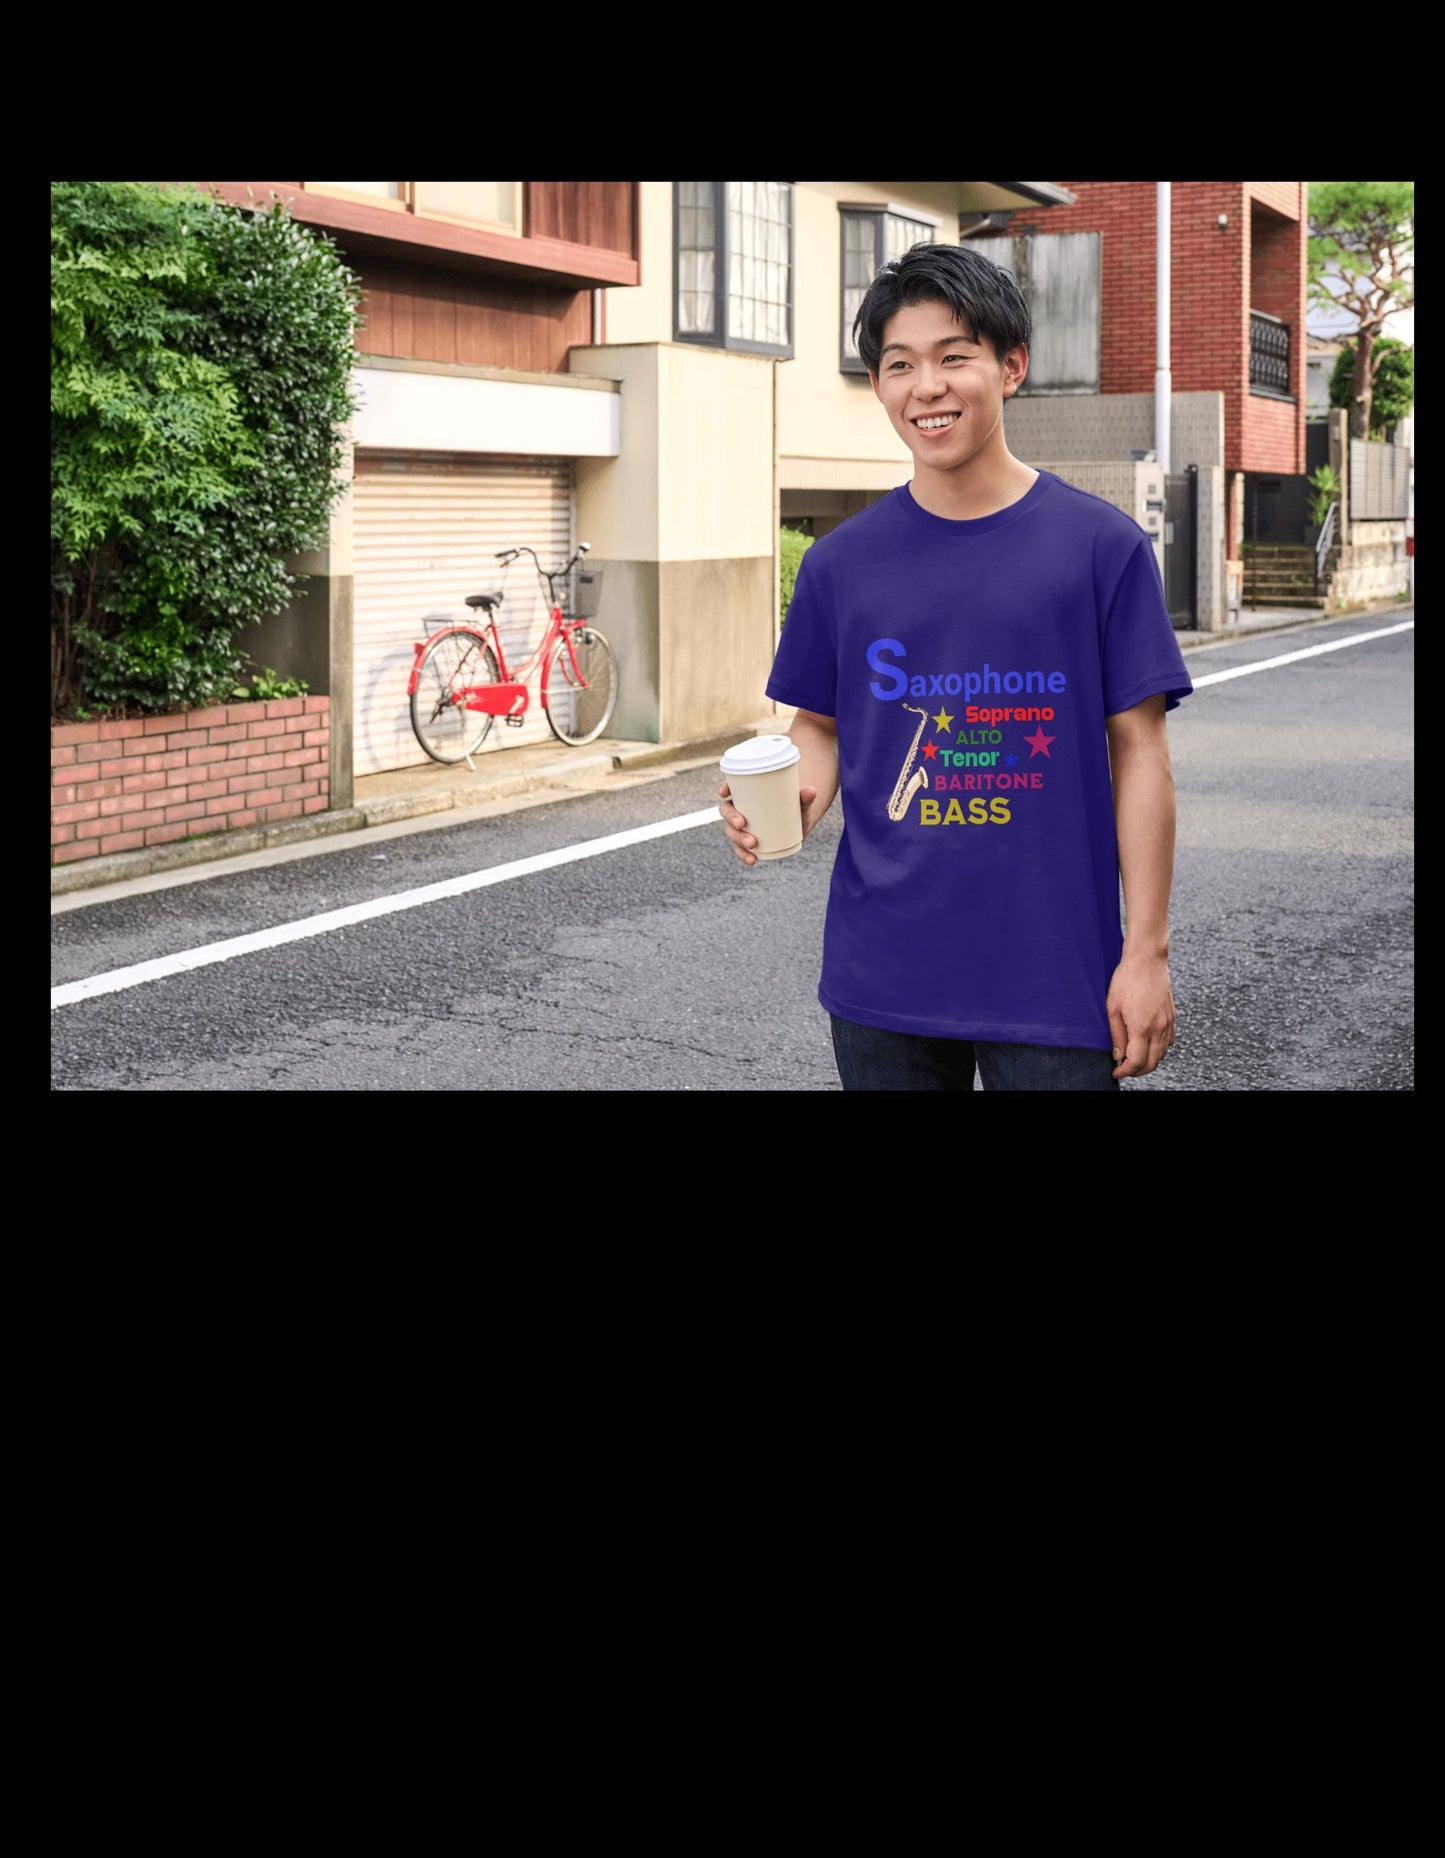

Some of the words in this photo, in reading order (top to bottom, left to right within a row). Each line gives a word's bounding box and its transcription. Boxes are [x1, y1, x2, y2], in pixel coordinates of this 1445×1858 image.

[866, 638, 1066, 702] Saxophone
[965, 705, 1055, 727] Soprano
[955, 729, 1003, 745] ALTO
[940, 749, 1000, 767] Tenor
[934, 772, 1044, 791] BARITONE
[919, 797, 1012, 826] BASS
